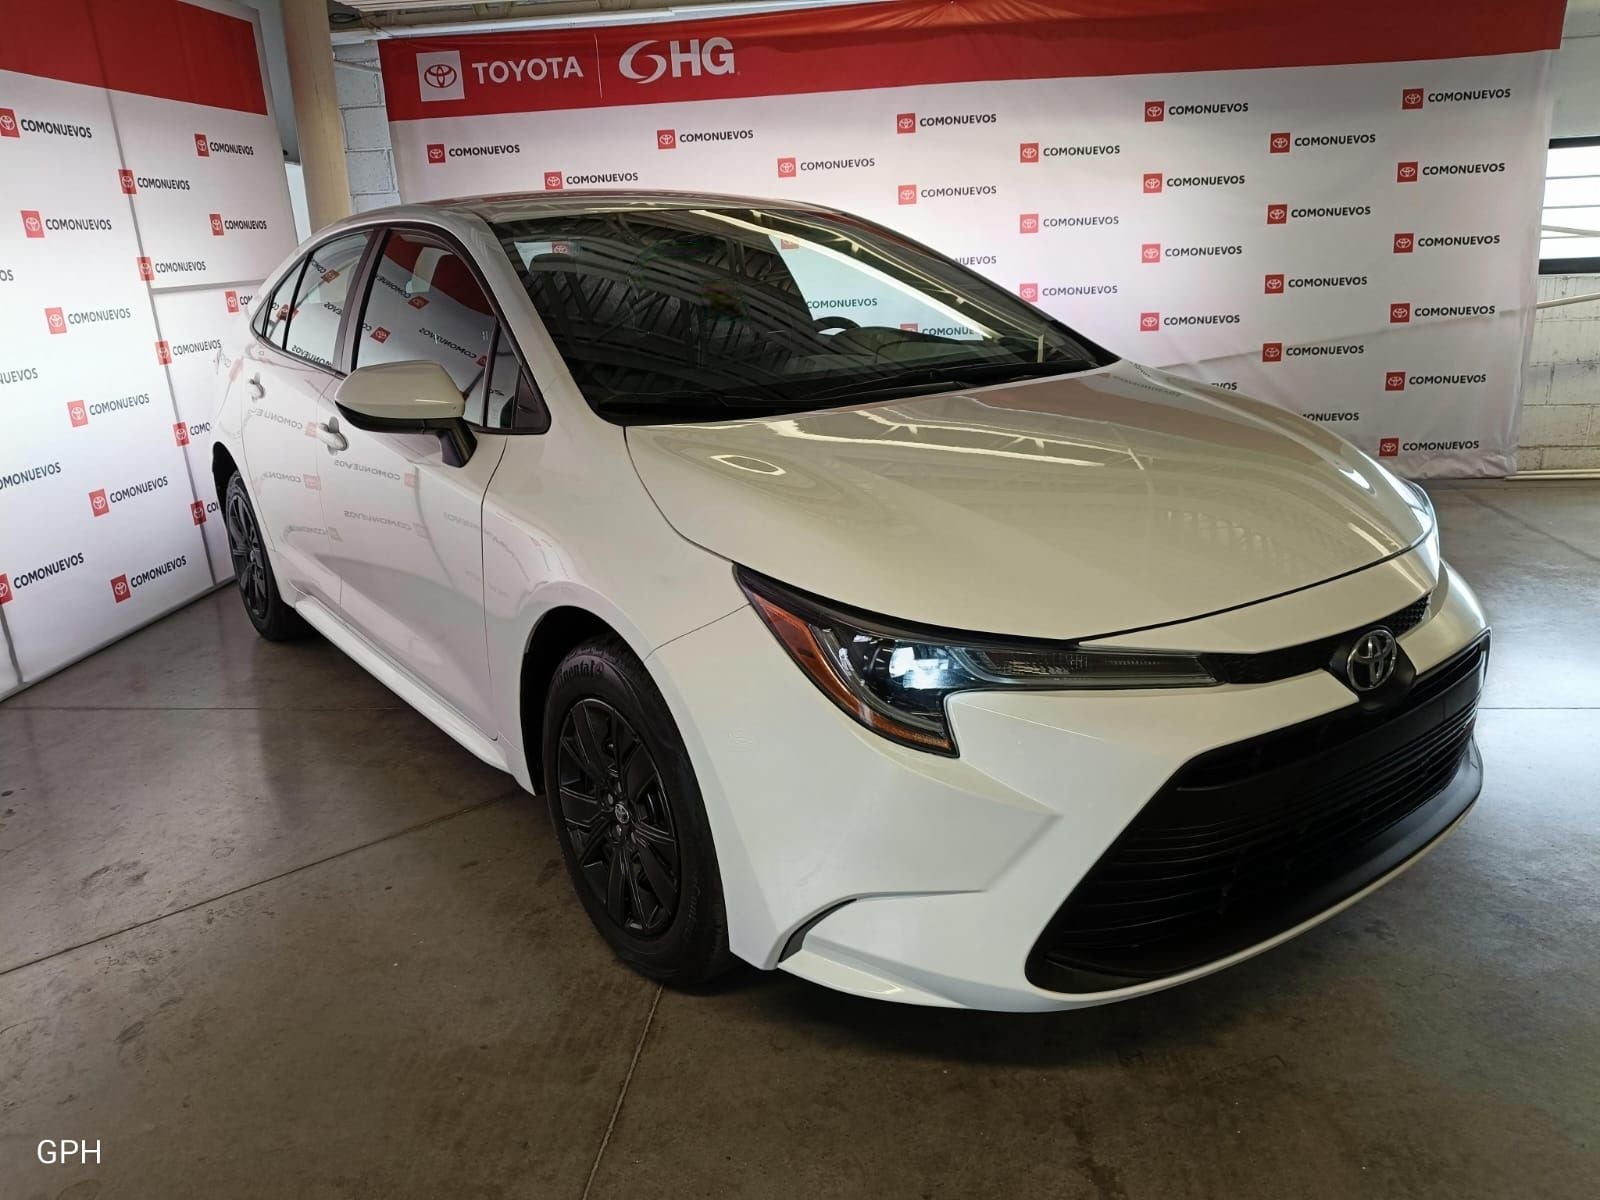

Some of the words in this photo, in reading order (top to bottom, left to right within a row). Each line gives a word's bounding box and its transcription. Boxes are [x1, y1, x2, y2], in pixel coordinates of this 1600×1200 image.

[669, 36, 736, 78] HG
[471, 56, 584, 84] TOYOTA
[1427, 88, 1511, 103] COMONUEVOS
[1168, 102, 1249, 116] COMONUEVOS
[919, 113, 997, 127] COMONUEVOS
[20, 119, 93, 139] COMONUEVOS
[679, 129, 754, 143] COMONUEVOS
[1294, 133, 1376, 147] COMONUEVOS
[208, 140, 255, 157] COMONUEVOS
[448, 144, 520, 158] COMONUEVOS
[1042, 144, 1121, 157] COMONUEVOS
[800, 157, 876, 171] COMONUEVOS
[1422, 162, 1505, 176] COMONUEVOS
[137, 177, 191, 191] COMONUEVOS
[566, 172, 639, 185] COMONUEVOS
[1166, 175, 1246, 187] COMONUEVOS
[920, 185, 997, 198] COMONUEVOS
[1290, 205, 1371, 218] COMONUEVOS
[45, 218, 113, 231] COMONUEVOS
[224, 219, 268, 230] COMONUEVOS
[1042, 215, 1120, 228] COMONUEVOS
[1417, 234, 1501, 248] COMONUEVOS
[1164, 245, 1243, 257] COMONUEVOS
[154, 260, 207, 274] COMONUEVOS
[1287, 275, 1368, 288] COMONUEVOS
[1041, 284, 1118, 297] COMONUEVOS
[806, 297, 878, 310] COMONUEVOS
[67, 307, 132, 325] COMONUEVOS
[1414, 305, 1496, 317] COMONUEVOS
[1163, 314, 1241, 326] COMONUEVOS
[922, 326, 977, 337] COMONUE
[171, 338, 222, 358] COMONUEVOS
[1285, 344, 1365, 357] COMONUEVOS
[1408, 373, 1487, 385] COMONUEVOS
[89, 393, 150, 416] COMONUEVOS
[1302, 412, 1360, 422] ONUEVOS
[1402, 440, 1480, 452] COMONUEVOS
[109, 476, 169, 504] COMONUEVOS
[13, 553, 85, 590] COMONUEVOS
[130, 556, 187, 588] COMONUEVOS
